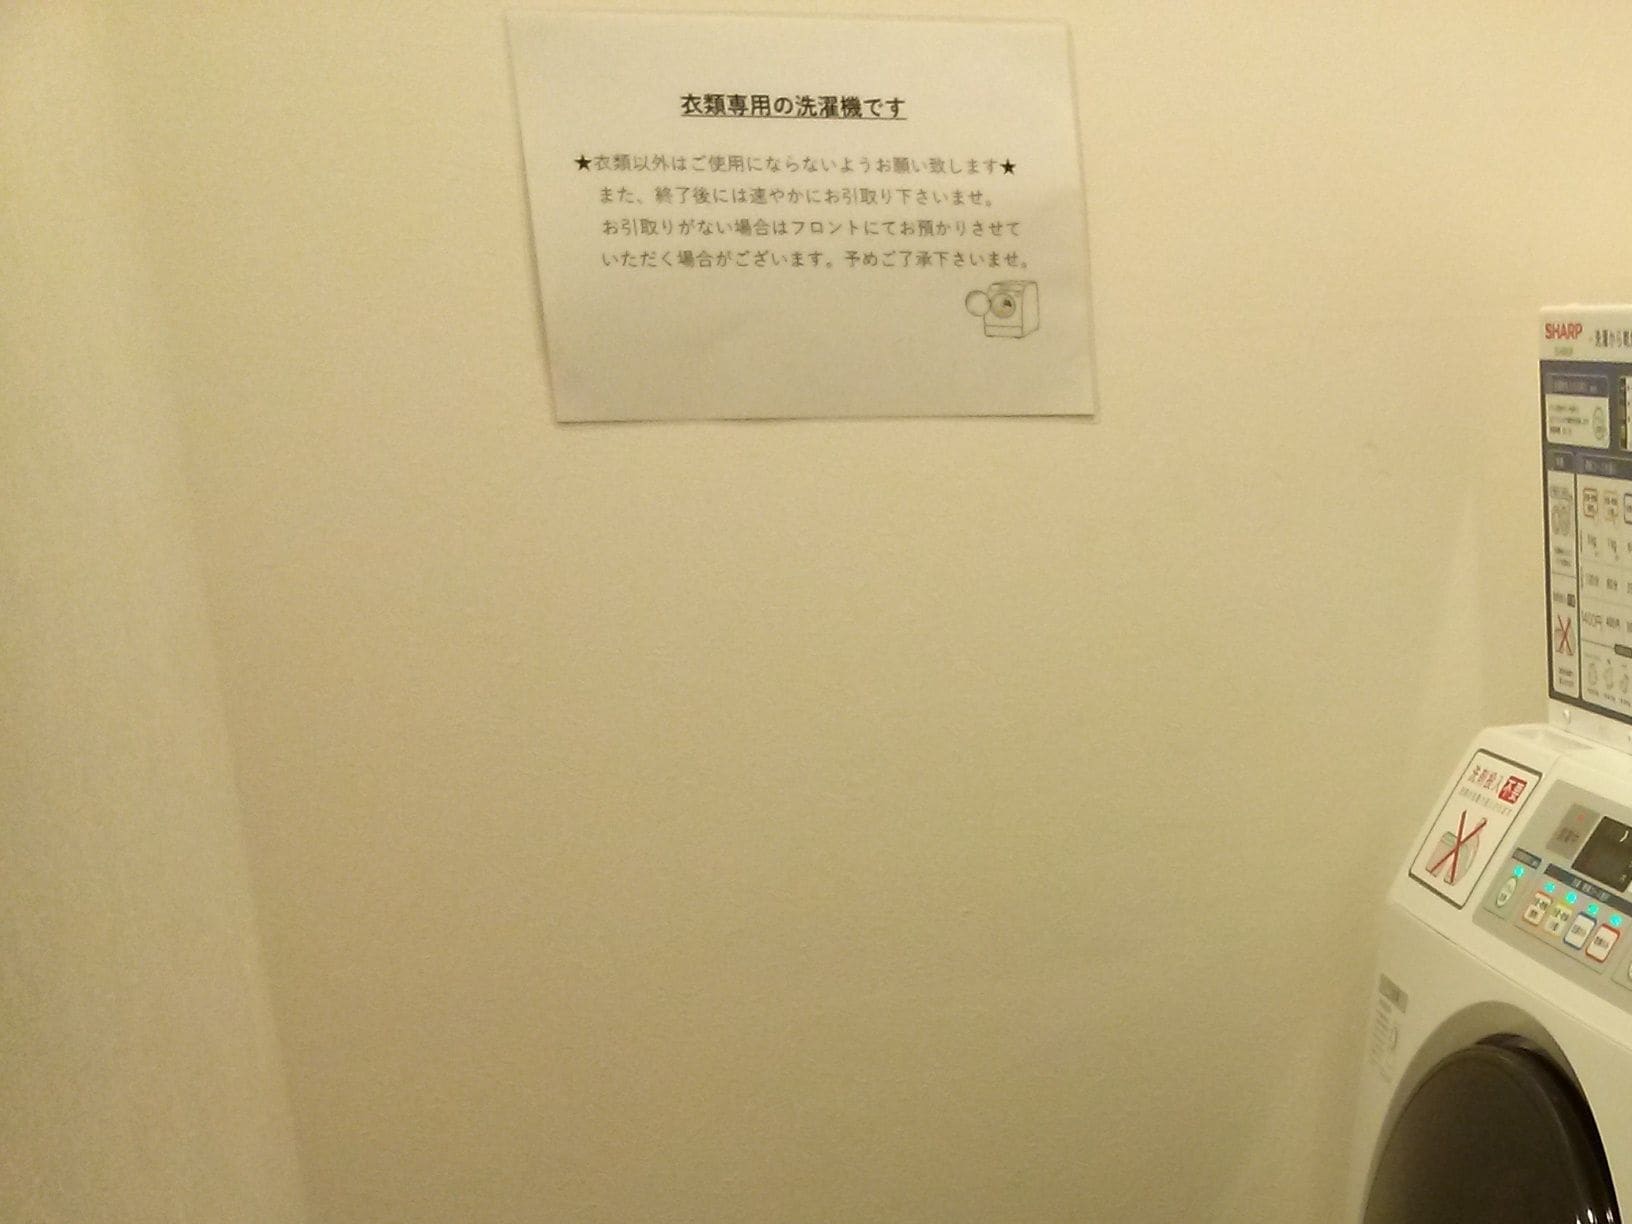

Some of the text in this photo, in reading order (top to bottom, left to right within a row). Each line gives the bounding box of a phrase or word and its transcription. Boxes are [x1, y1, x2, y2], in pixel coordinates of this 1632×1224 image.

[680, 93, 907, 119] 衣類専用の洗濯機です
[602, 218, 1022, 238] お引取りがない場合はフロントにてお預かりさせて
[1544, 321, 1583, 340] SHARP
